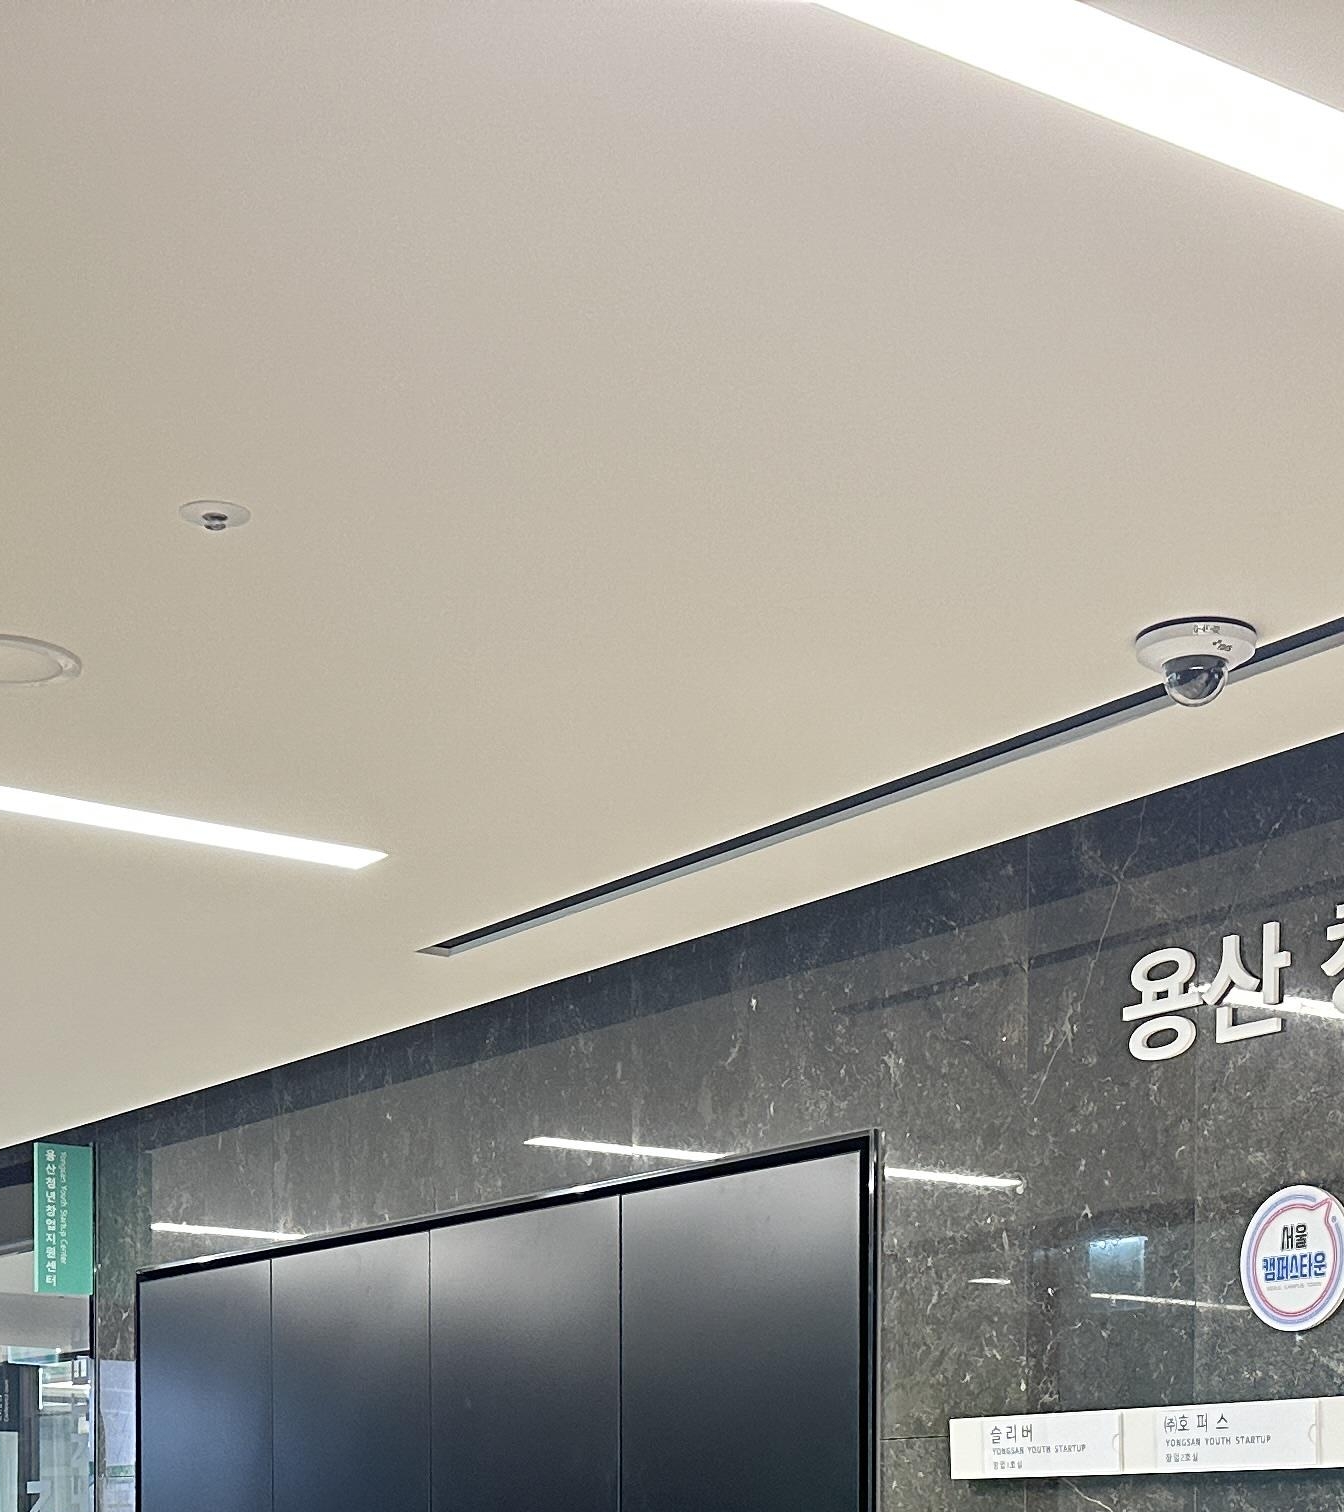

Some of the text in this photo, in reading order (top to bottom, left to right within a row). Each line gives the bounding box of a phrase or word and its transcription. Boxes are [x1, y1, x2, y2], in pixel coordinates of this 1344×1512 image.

[1121, 916, 1291, 1063] 용산
[1281, 1223, 1307, 1250] 서울
[1262, 1251, 1327, 1281] 캠퍼스타운
[989, 1423, 1033, 1445] 슬리버
[1165, 1434, 1272, 1448] YONGSAN YOUTH STARTUP
